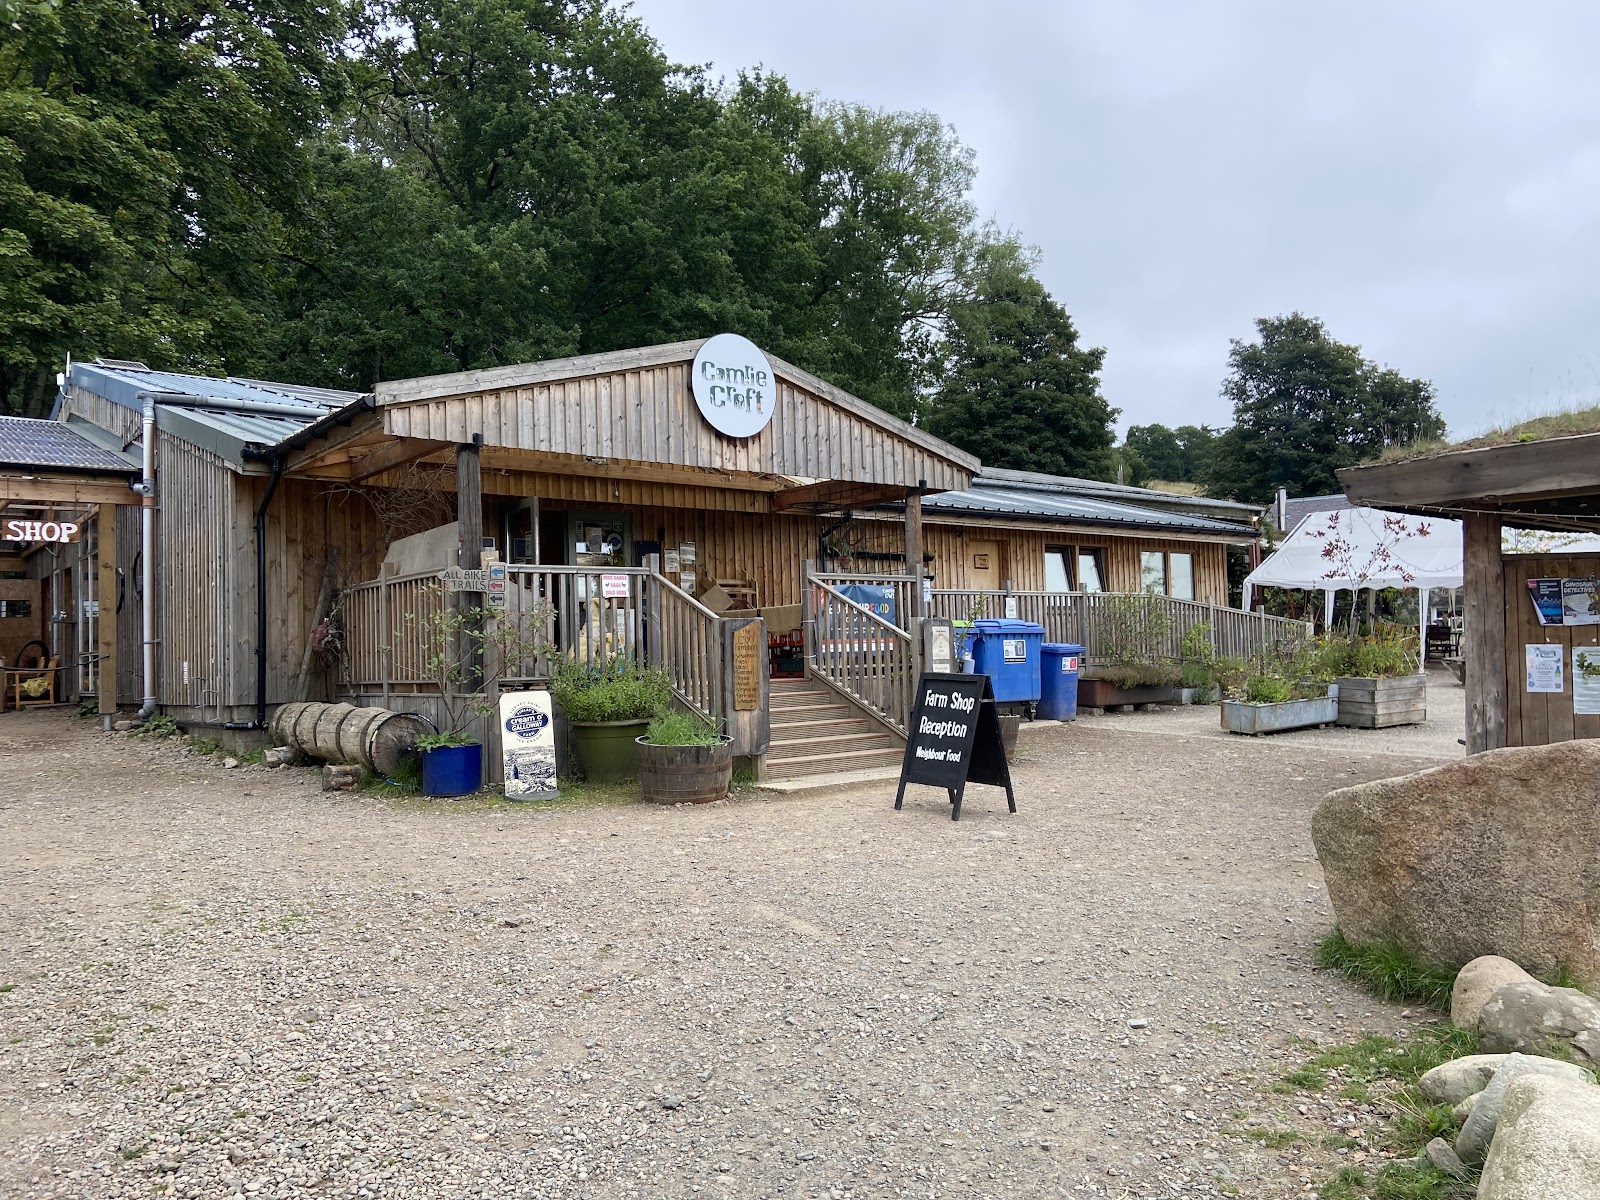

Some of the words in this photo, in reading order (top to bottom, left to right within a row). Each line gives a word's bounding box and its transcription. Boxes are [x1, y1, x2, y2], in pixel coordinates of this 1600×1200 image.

[710, 386, 763, 414] Croft
[6, 520, 78, 542] SHOP
[443, 571, 460, 579] ALL
[464, 570, 487, 580] BIKE
[451, 580, 486, 590] TRAILS
[925, 689, 948, 708] Farm
[950, 692, 975, 714] Shop
[510, 716, 535, 724] cream
[511, 720, 542, 731] GALLOWAY
[919, 716, 967, 739] Reception
[916, 746, 946, 760] Neighbour
[946, 749, 961, 762] Food
